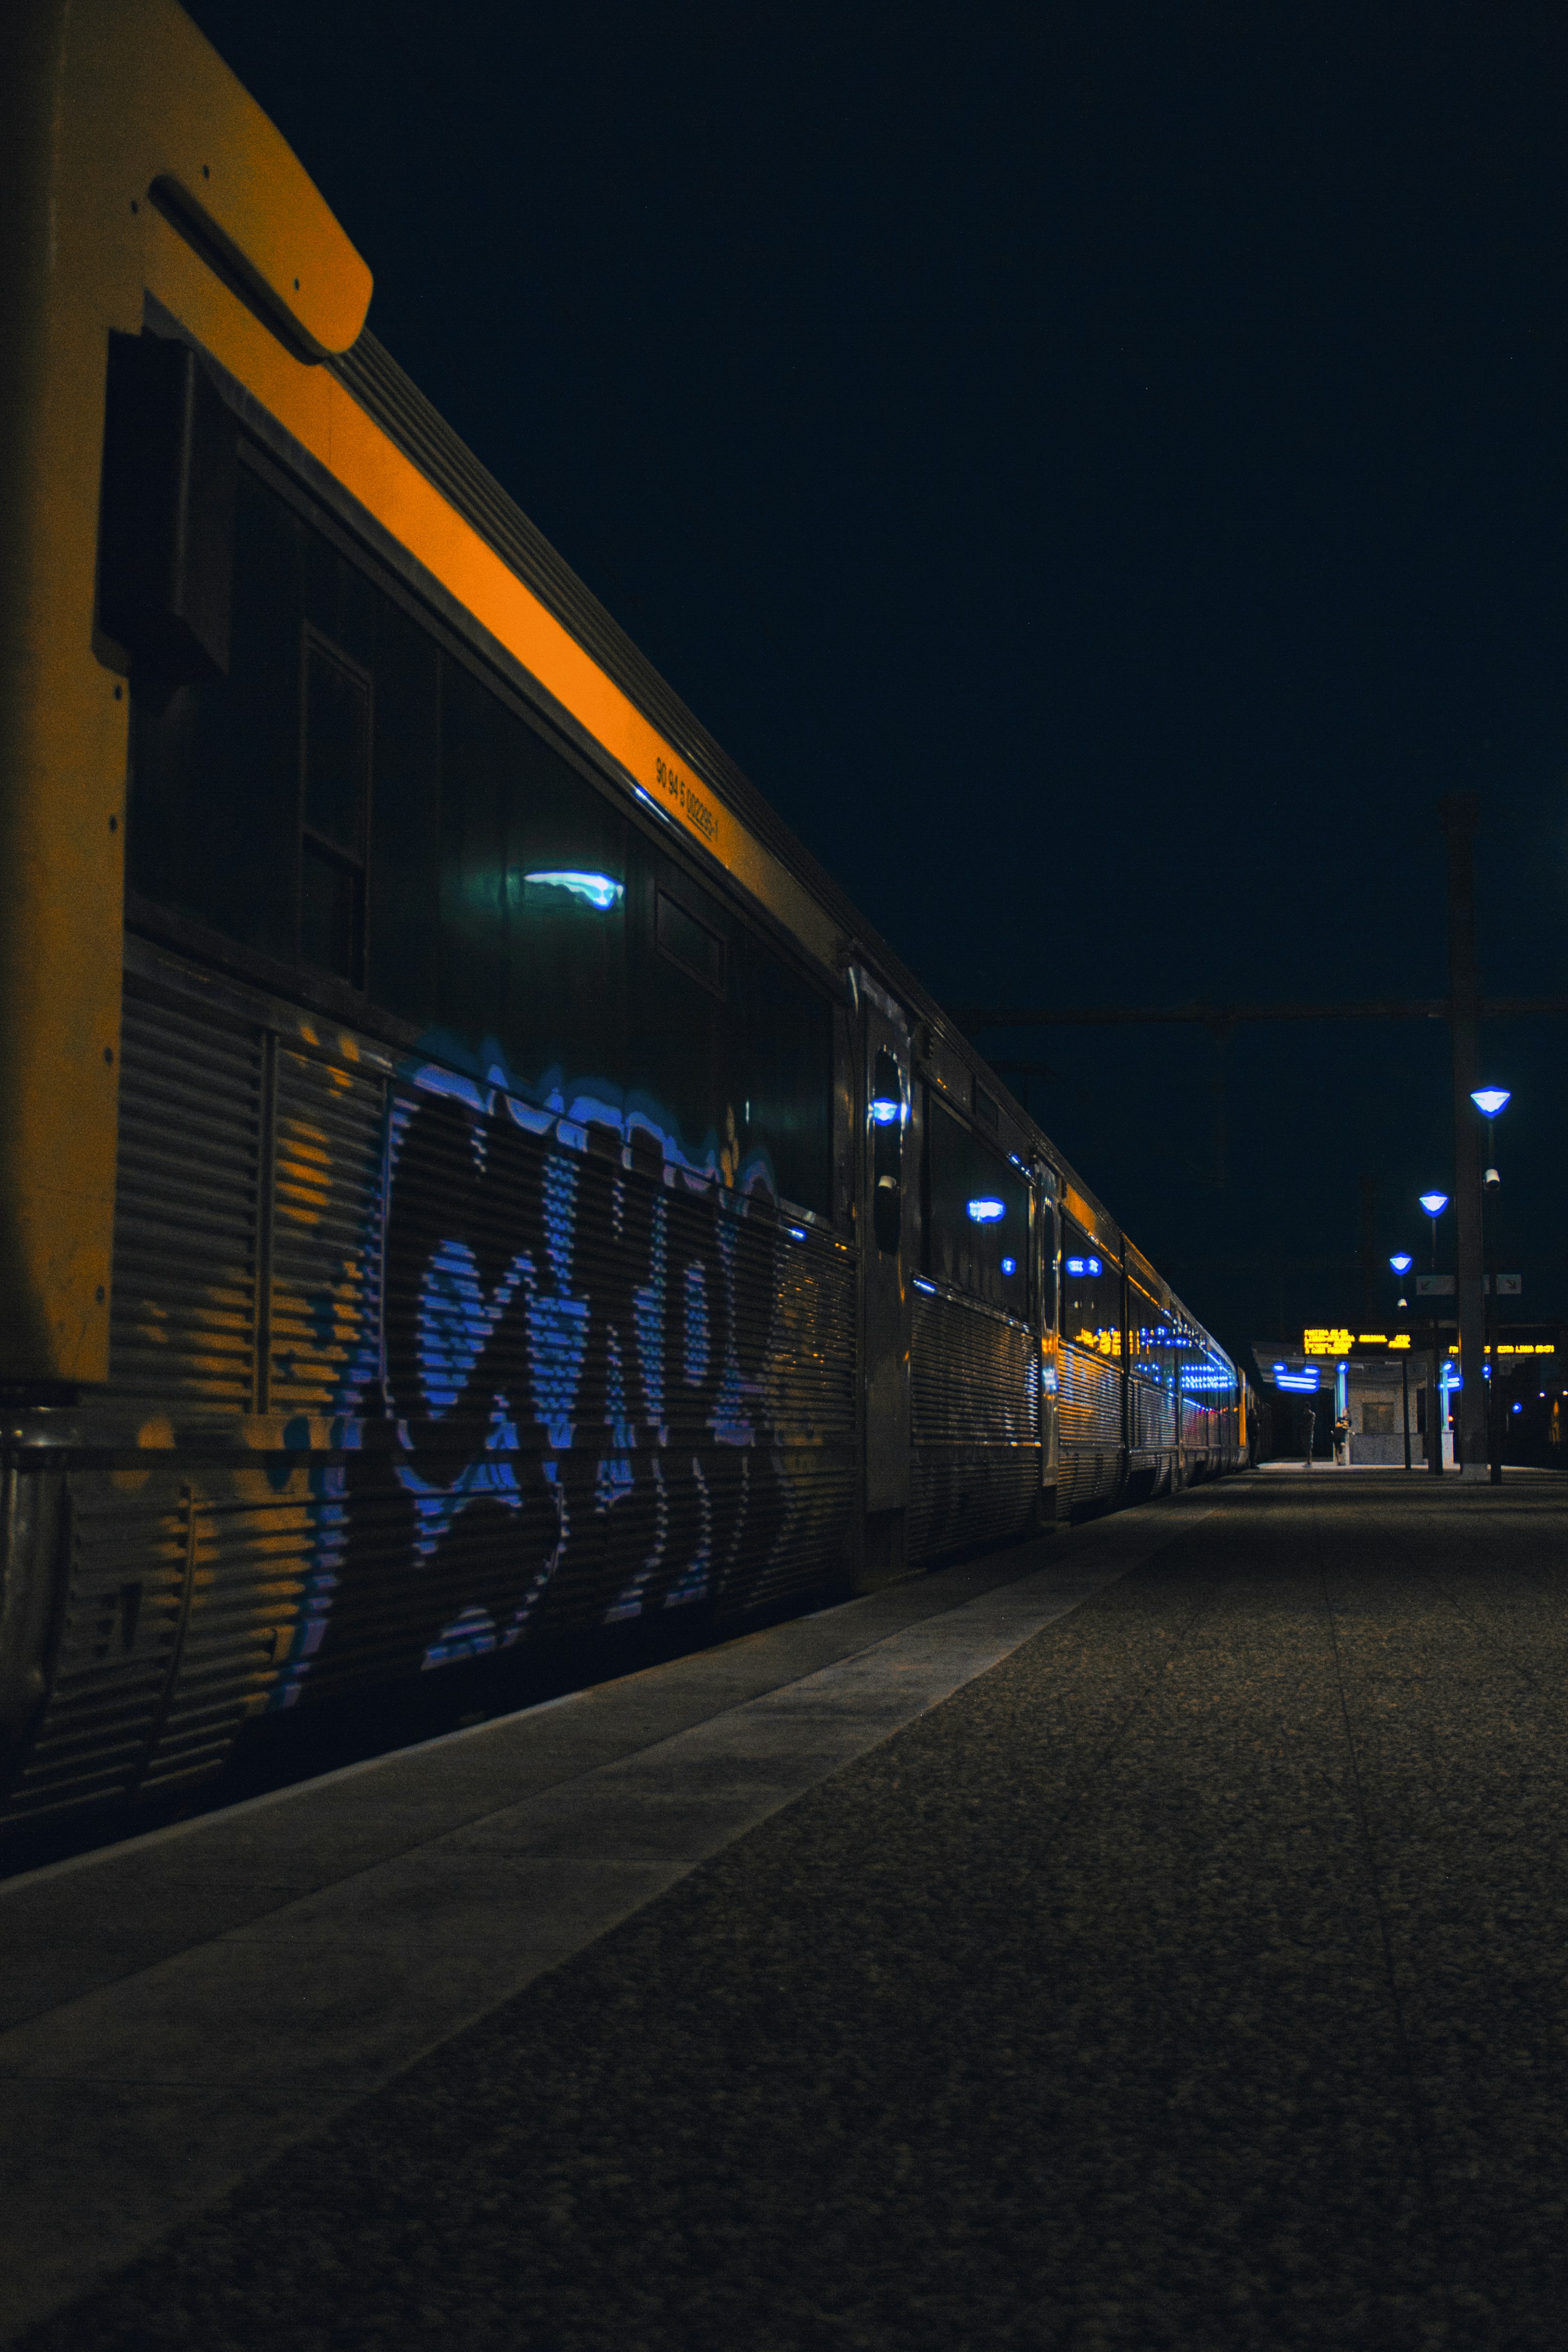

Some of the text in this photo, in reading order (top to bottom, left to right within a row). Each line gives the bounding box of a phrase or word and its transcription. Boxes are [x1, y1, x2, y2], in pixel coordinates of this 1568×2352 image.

[657, 757, 667, 788] 90
[669, 769, 678, 798] 94
[680, 781, 685, 807] 5
